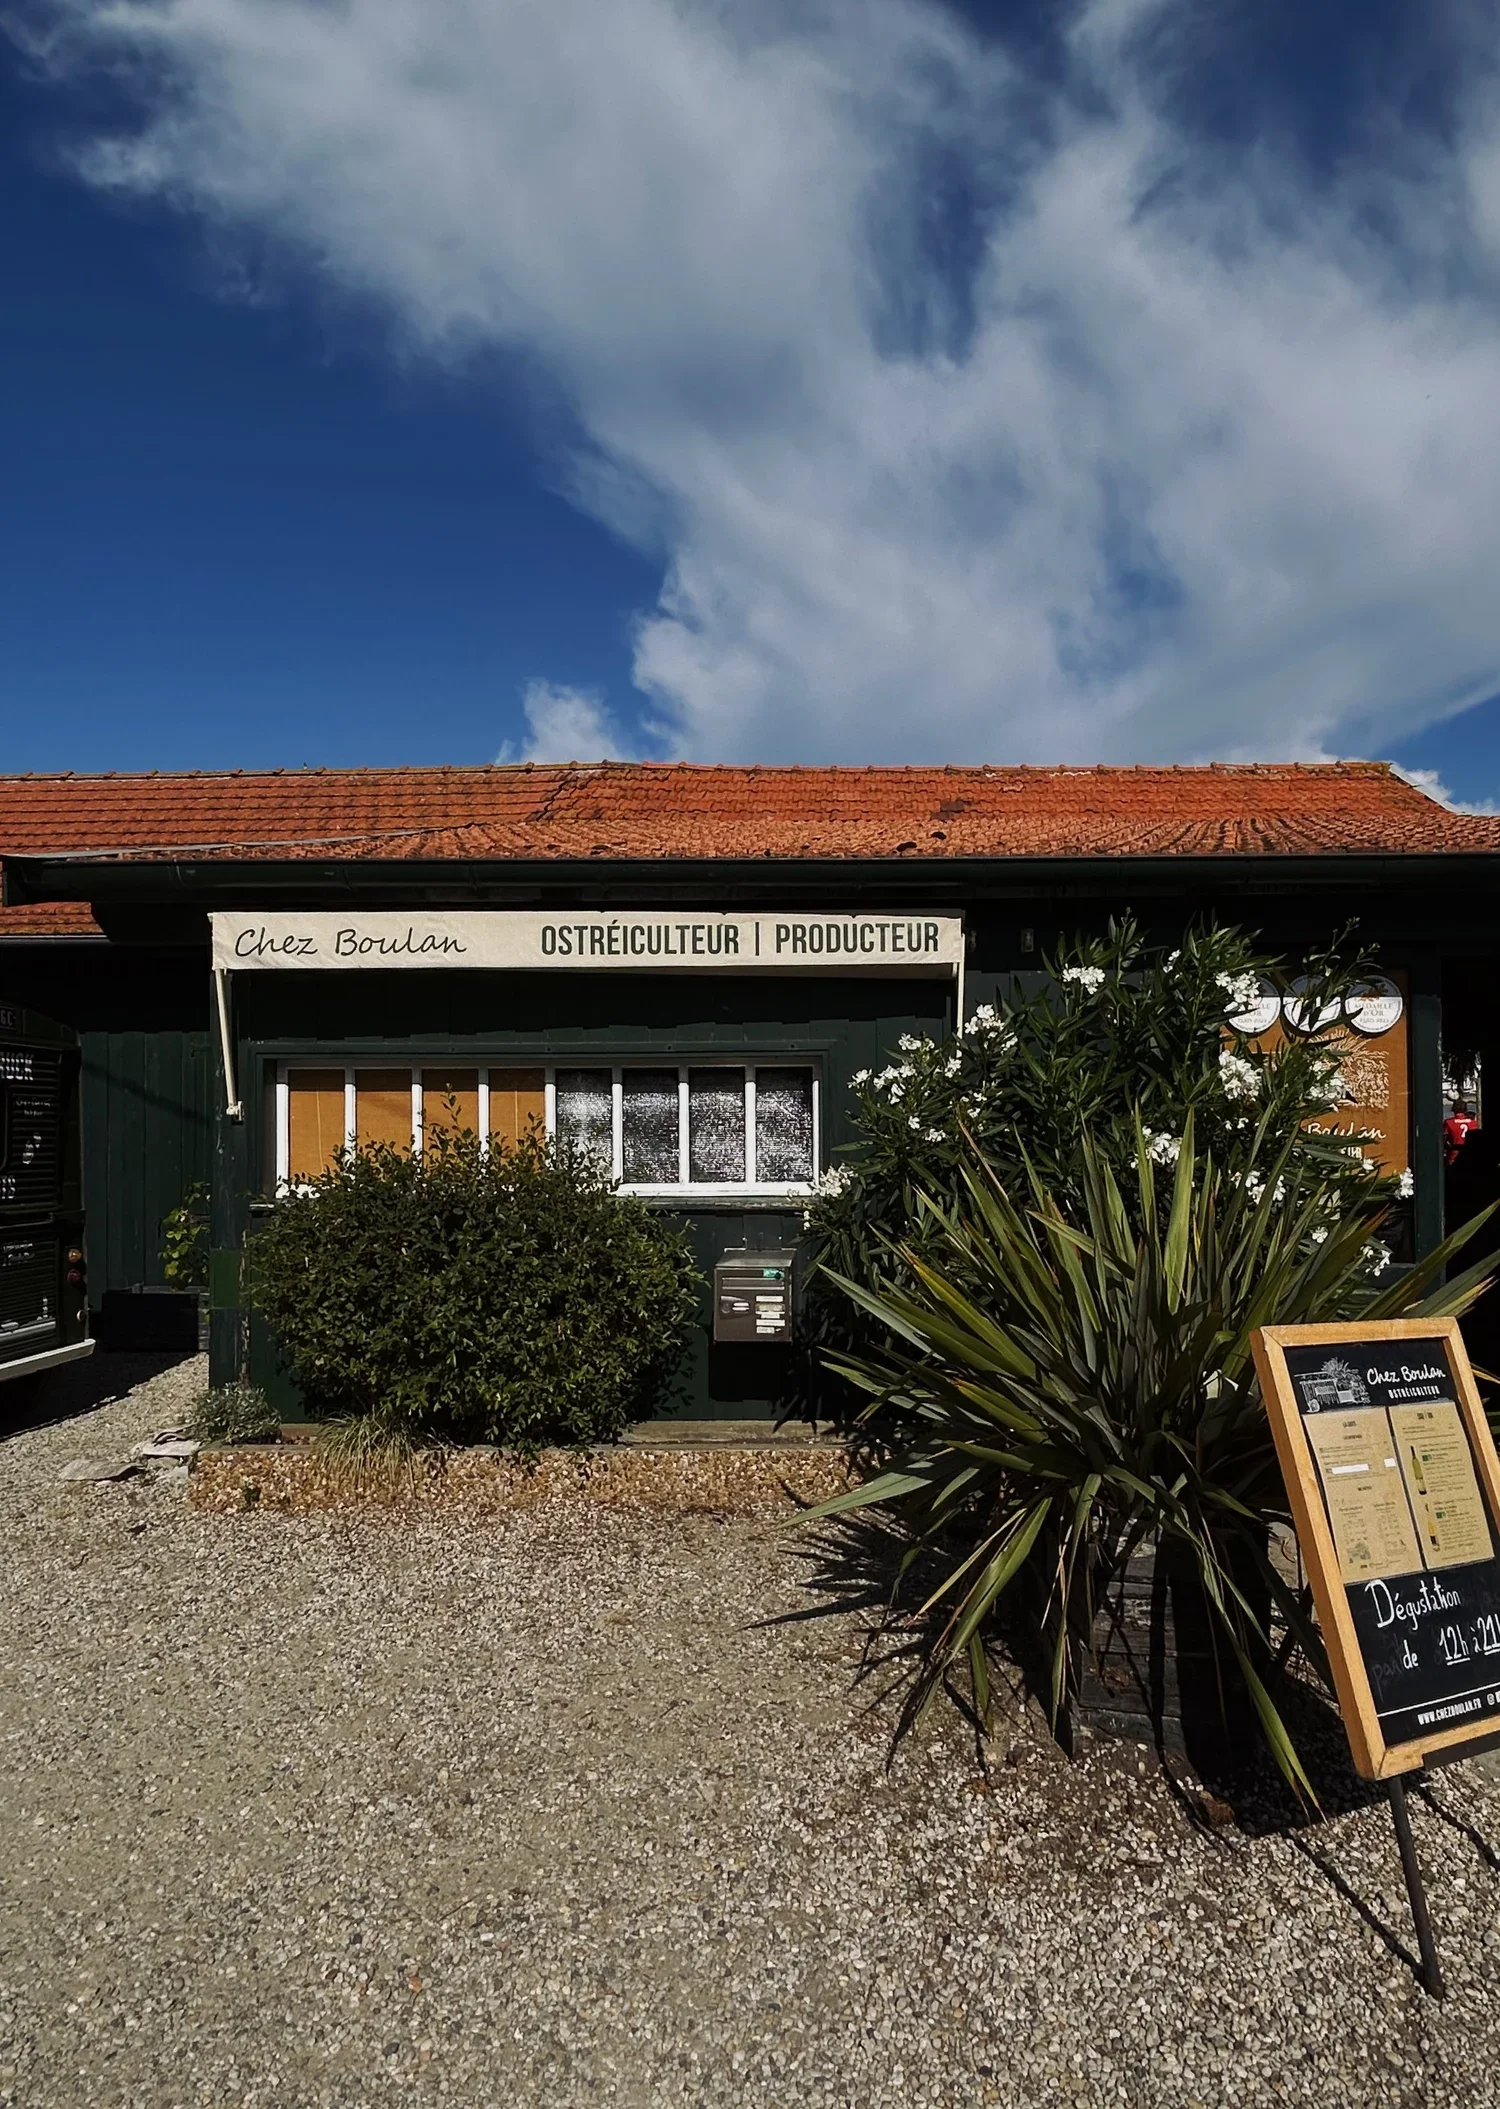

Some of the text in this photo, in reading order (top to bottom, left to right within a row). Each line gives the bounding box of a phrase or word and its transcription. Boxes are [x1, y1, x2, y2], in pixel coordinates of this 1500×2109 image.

[235, 926, 318, 957] Chez
[335, 926, 468, 957] Boulan
[541, 919, 739, 955] OSTRÉICULTEUR
[775, 922, 939, 953] PRODUCTEUR
[1367, 1363, 1446, 1385] Chez Boulan
[1364, 1576, 1462, 1631] Dégustation
[1402, 1639, 1419, 1670] de
[1439, 1624, 1470, 1661] 12h
